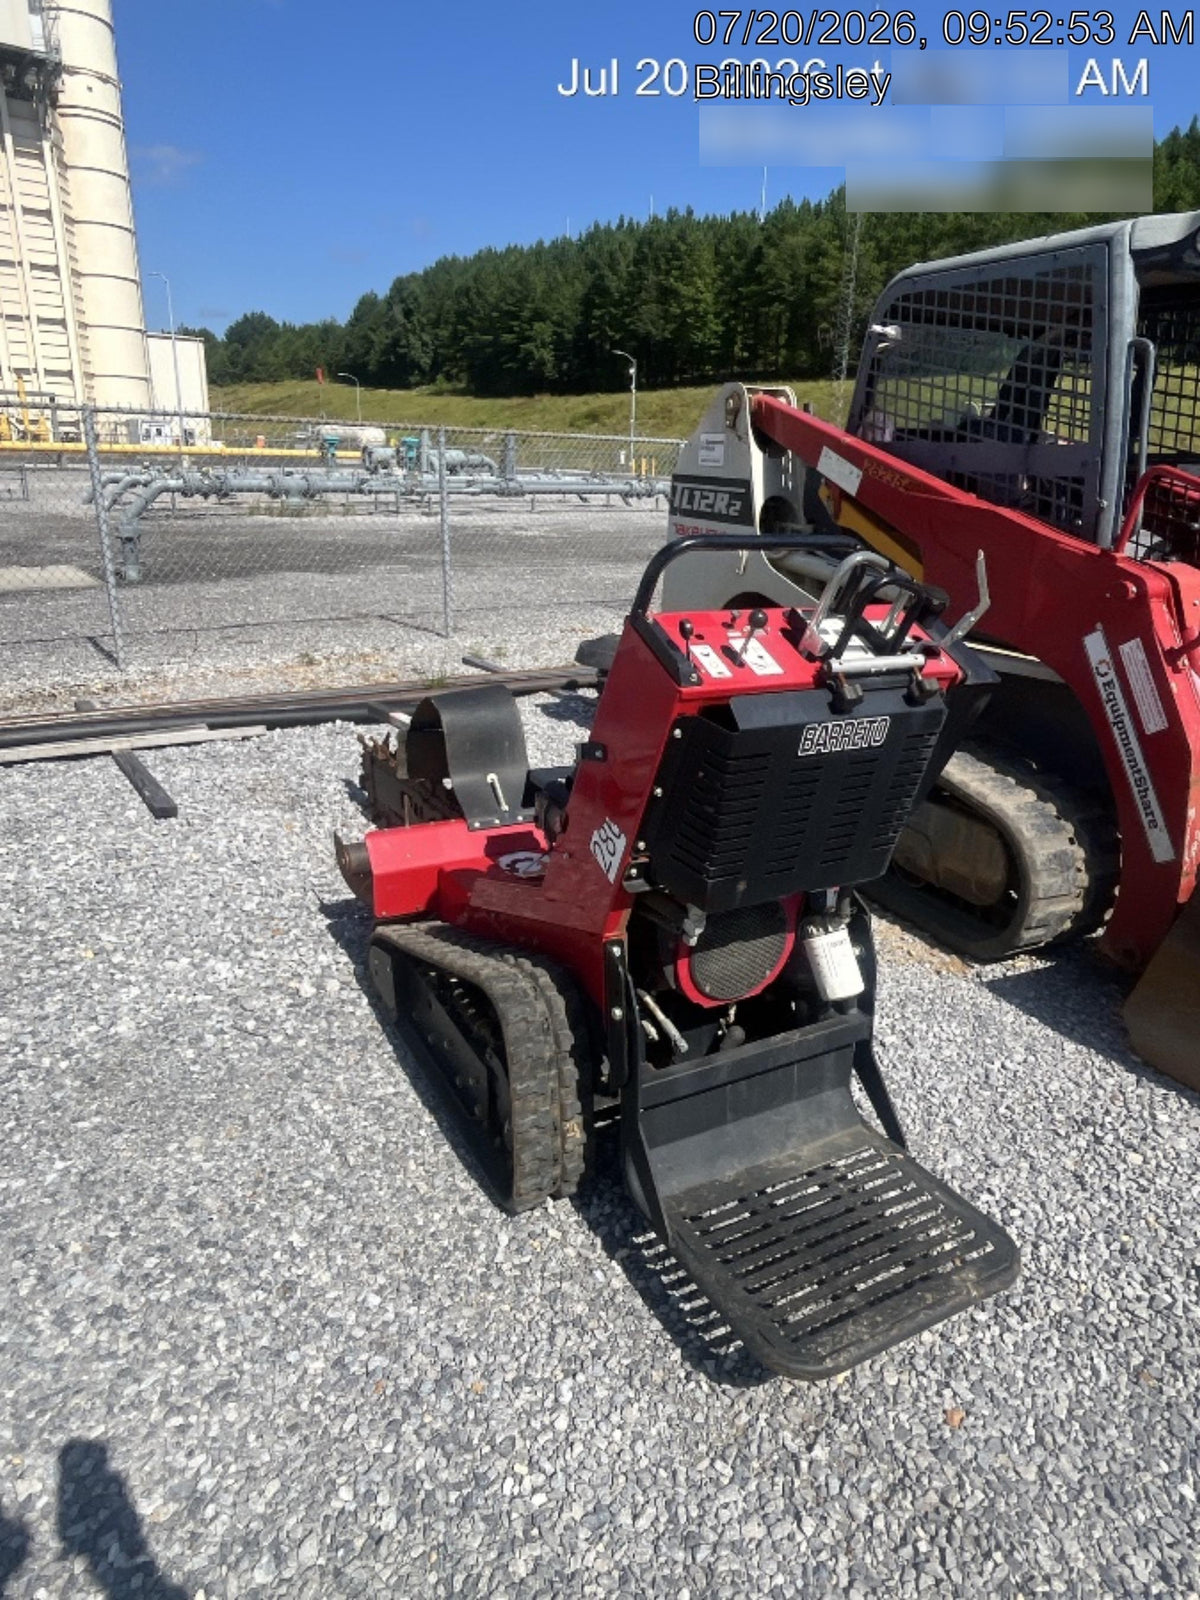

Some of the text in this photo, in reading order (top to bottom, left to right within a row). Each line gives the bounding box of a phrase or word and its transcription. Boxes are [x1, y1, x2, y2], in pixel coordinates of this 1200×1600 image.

[672, 482, 746, 517] TL12R2
[798, 716, 890, 756] BARRETO
[1102, 678, 1159, 831] EquipmentShare
